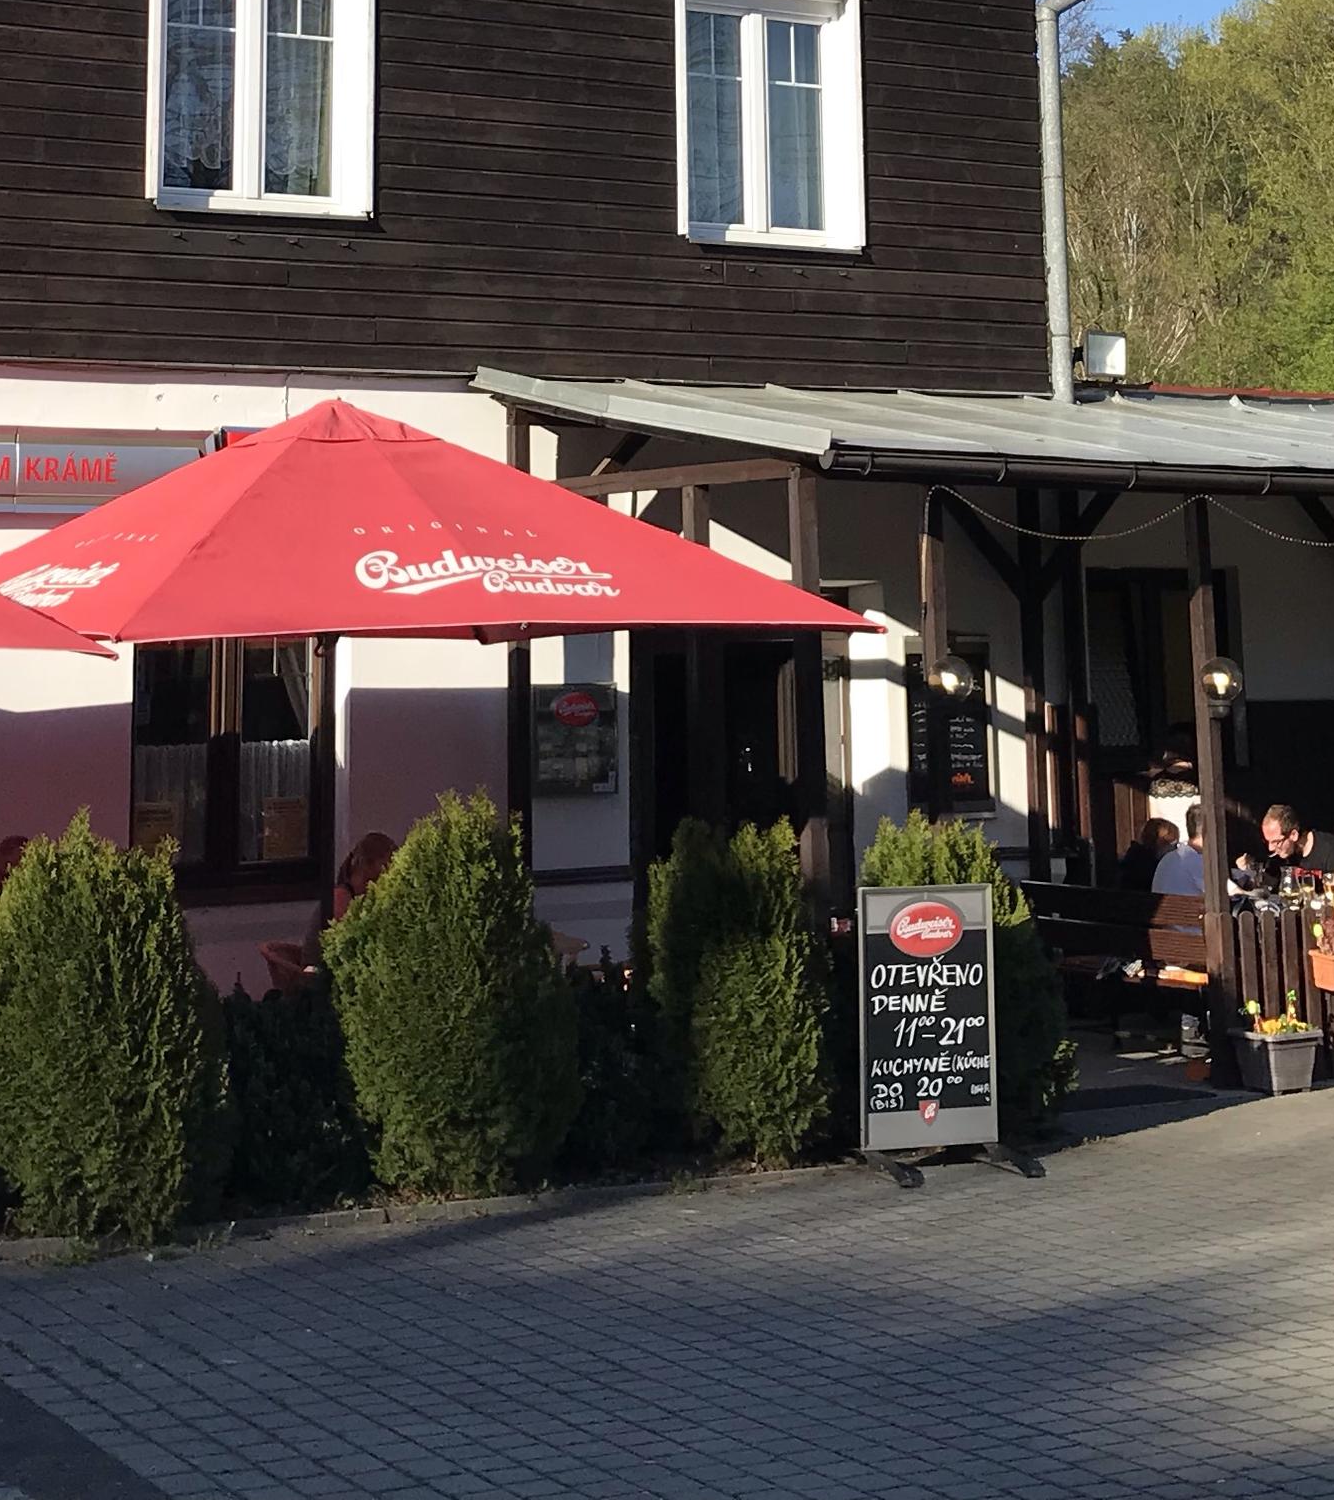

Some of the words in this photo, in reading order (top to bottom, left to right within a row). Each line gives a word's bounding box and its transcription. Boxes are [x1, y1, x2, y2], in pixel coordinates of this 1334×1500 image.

[25, 452, 118, 483] KRÁMĚ
[353, 521, 537, 538] ORIGINAL
[355, 550, 613, 595] Budweiser
[482, 570, 620, 597] Budvar
[870, 955, 983, 988] OTEVŘENO
[870, 988, 948, 1015] DENNĚ
[870, 1095, 904, 1110] (BIS)
[872, 1082, 903, 1098] DO
